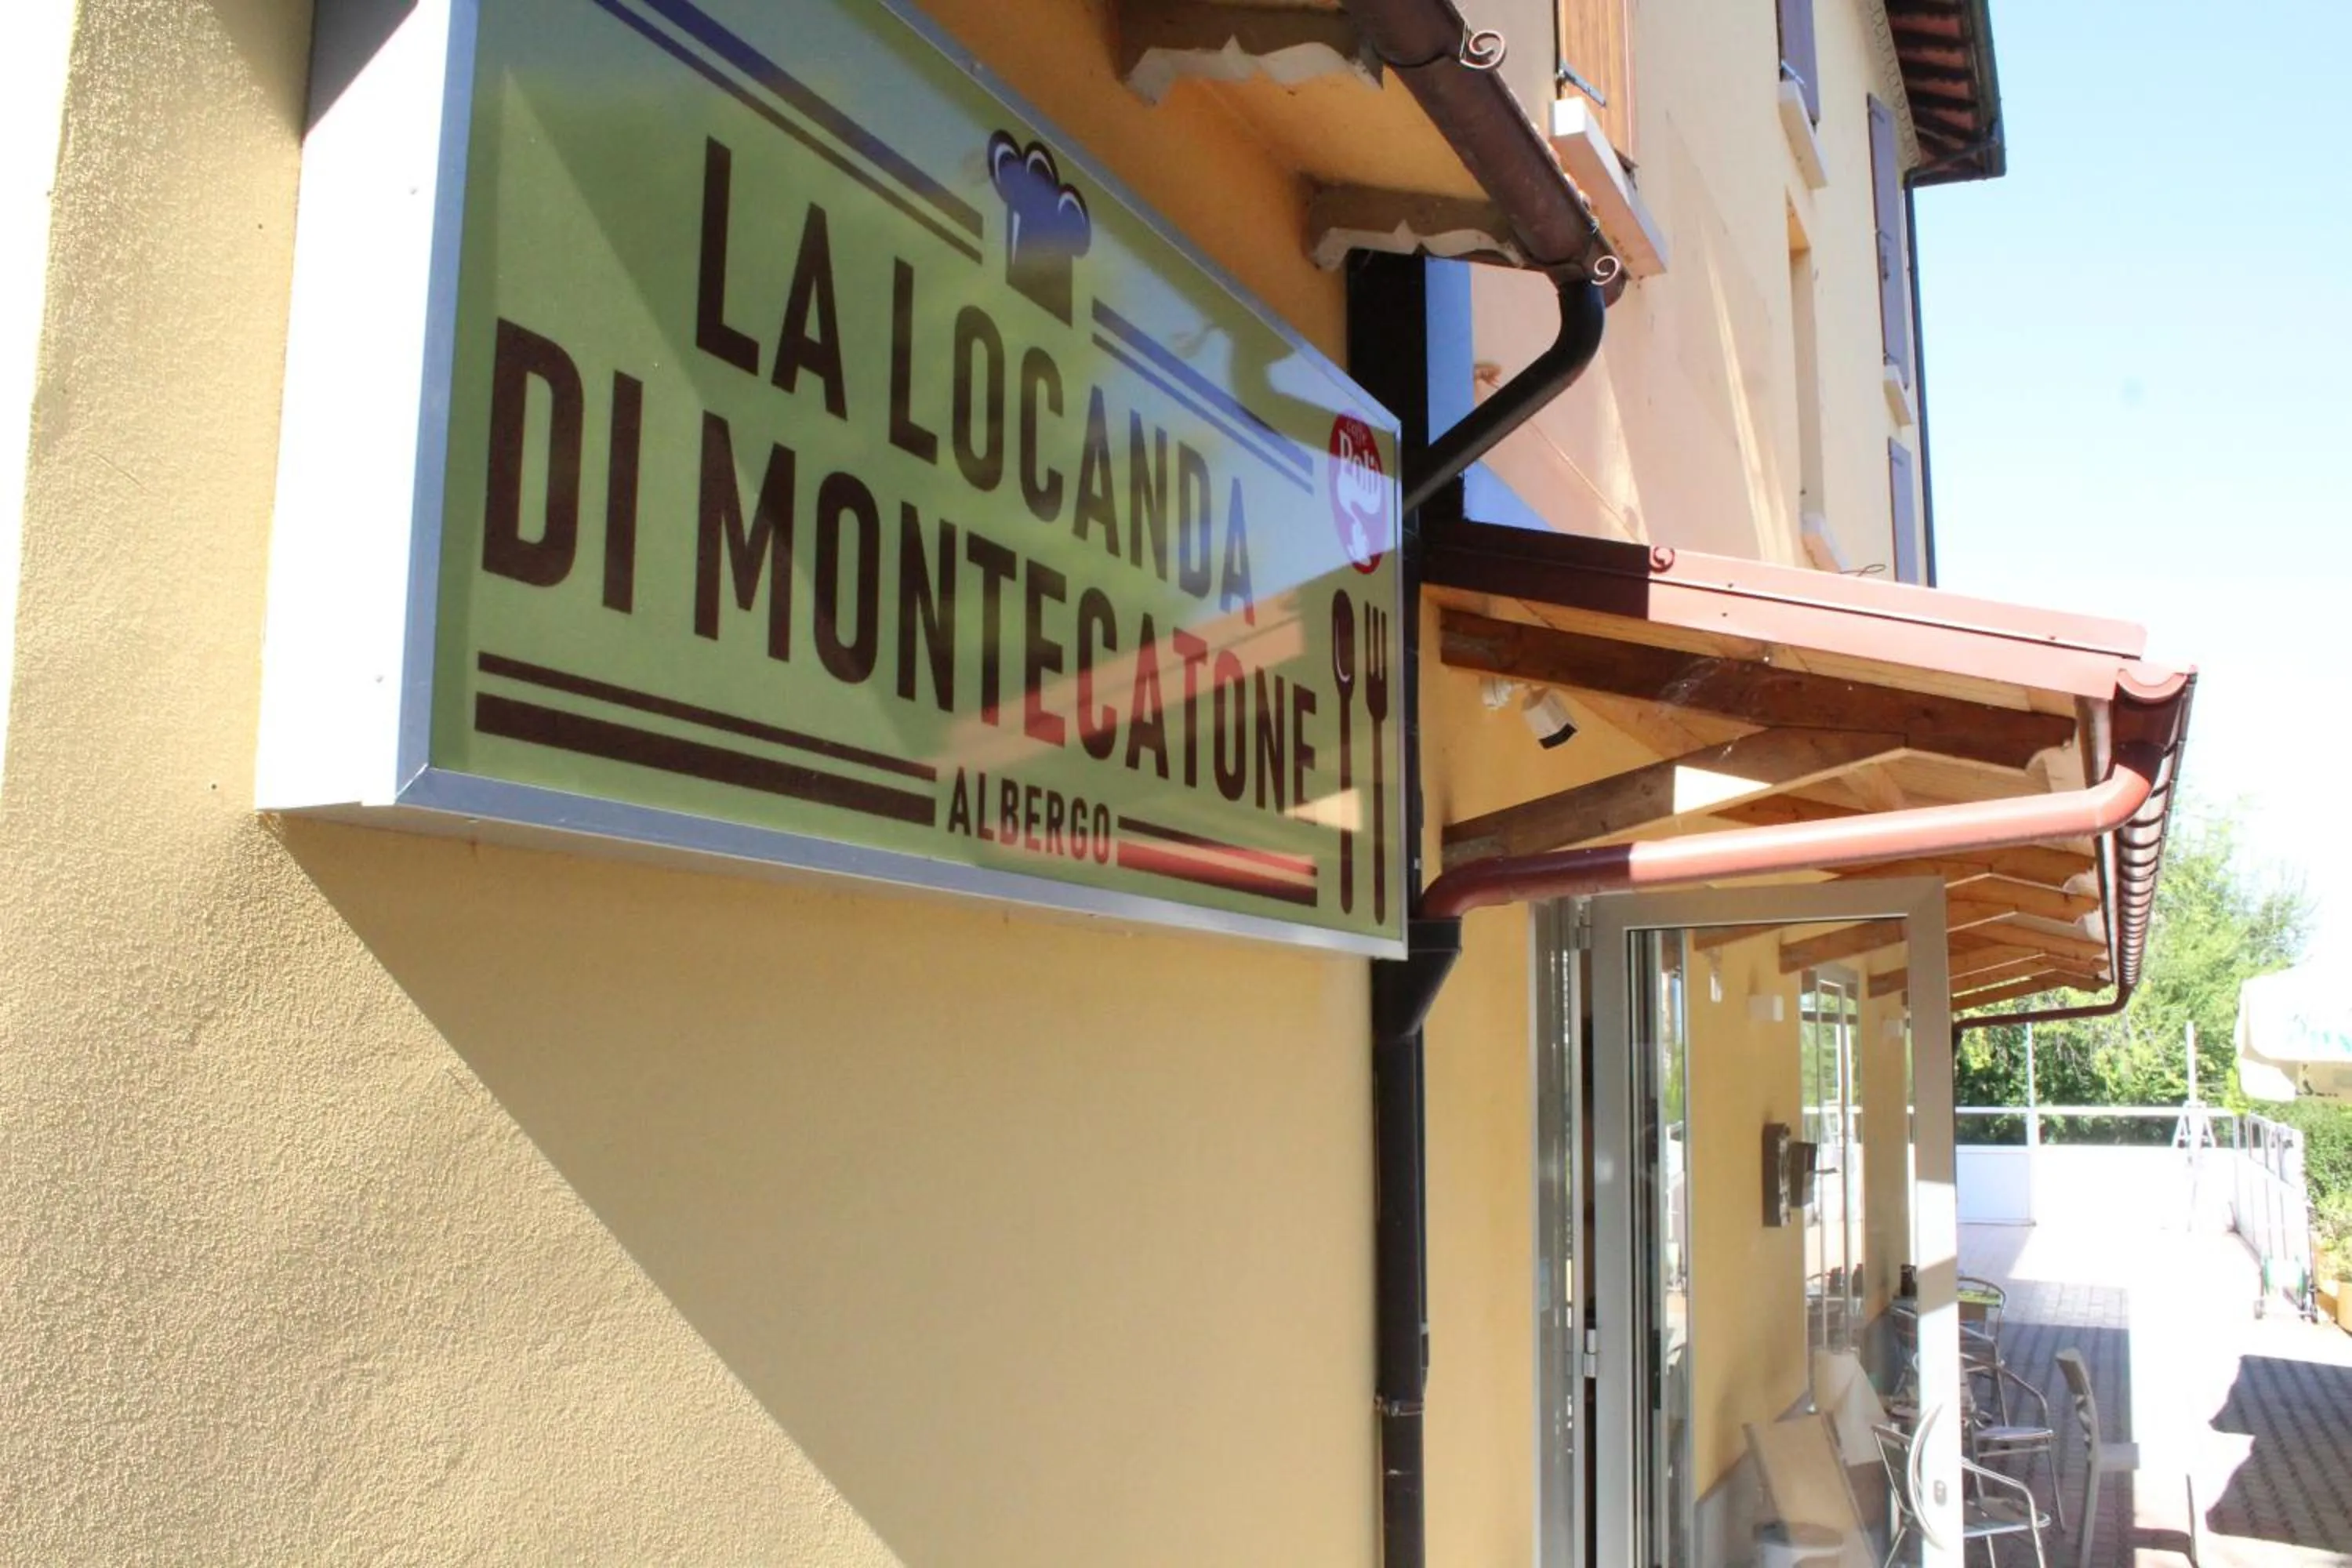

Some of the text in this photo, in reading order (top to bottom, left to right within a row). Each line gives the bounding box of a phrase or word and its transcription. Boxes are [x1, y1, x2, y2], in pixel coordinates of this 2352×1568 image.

[481, 316, 1318, 826] DI MONTECATONE
[695, 135, 1255, 626] LA LOCANDA
[947, 766, 1111, 867] ALBERGO
